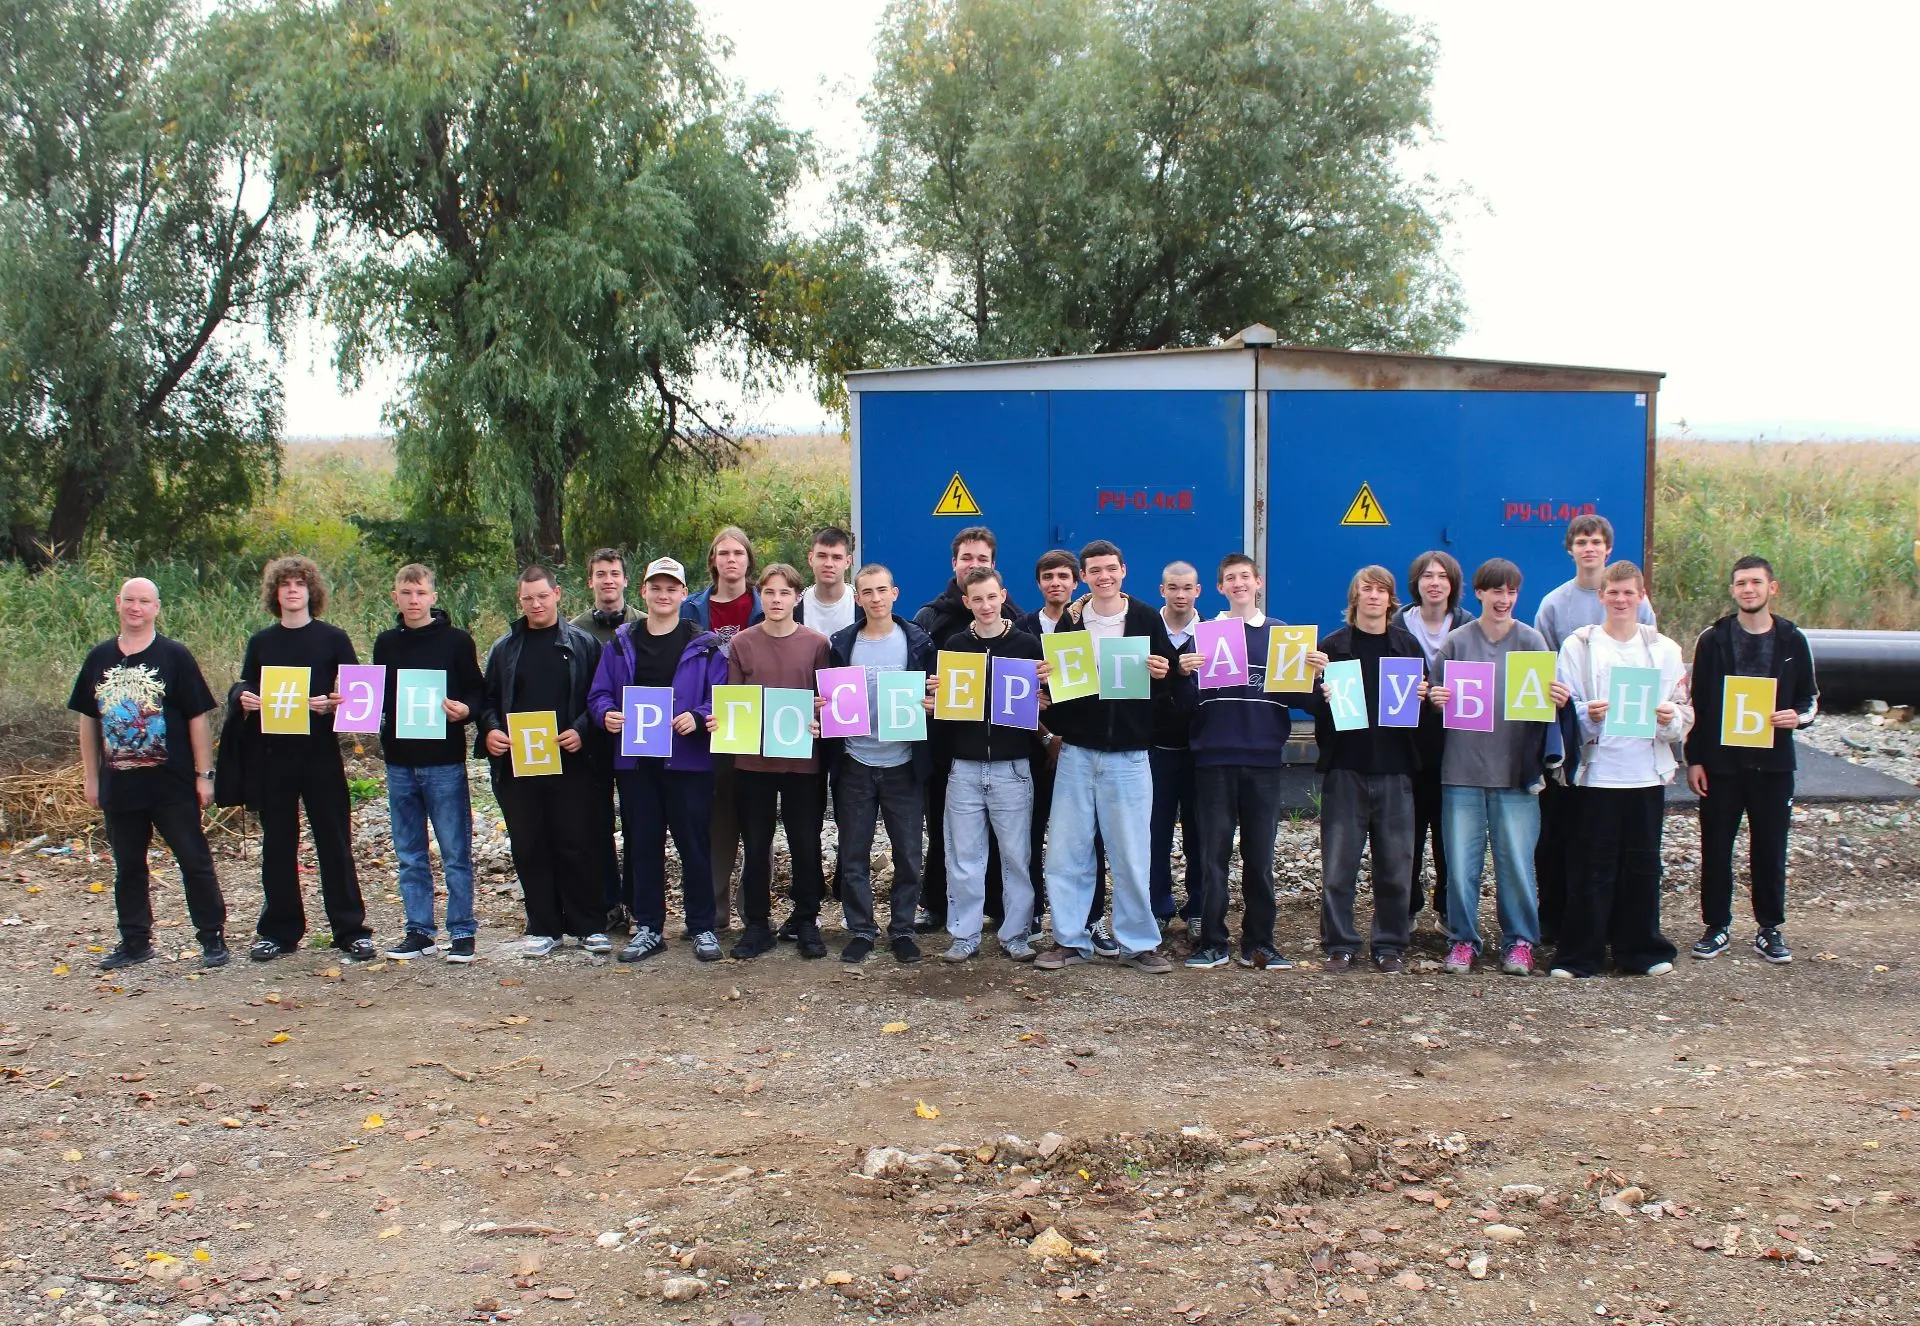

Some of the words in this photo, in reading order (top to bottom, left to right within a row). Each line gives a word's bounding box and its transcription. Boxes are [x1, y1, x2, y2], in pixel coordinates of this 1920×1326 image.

[1099, 491, 1193, 510] РУ-0.4кВ
[1056, 647, 1089, 689] Е
[1111, 654, 1140, 689] Г
[1205, 636, 1241, 678] А
[1272, 631, 1310, 681] Й
[344, 681, 375, 722] Э
[404, 686, 438, 726] Н
[831, 683, 860, 725] С
[887, 688, 916, 729] Б
[945, 668, 976, 709] Е
[1002, 674, 1031, 715] Р
[1331, 677, 1362, 718] К
[1386, 674, 1418, 715] У
[1453, 678, 1484, 719] Б
[1512, 668, 1549, 709] А
[1613, 683, 1652, 726] Н
[633, 703, 663, 744] Р
[723, 701, 752, 742] Г
[772, 705, 805, 746] О
[1732, 693, 1765, 735] Ь
[520, 728, 552, 765] Е
